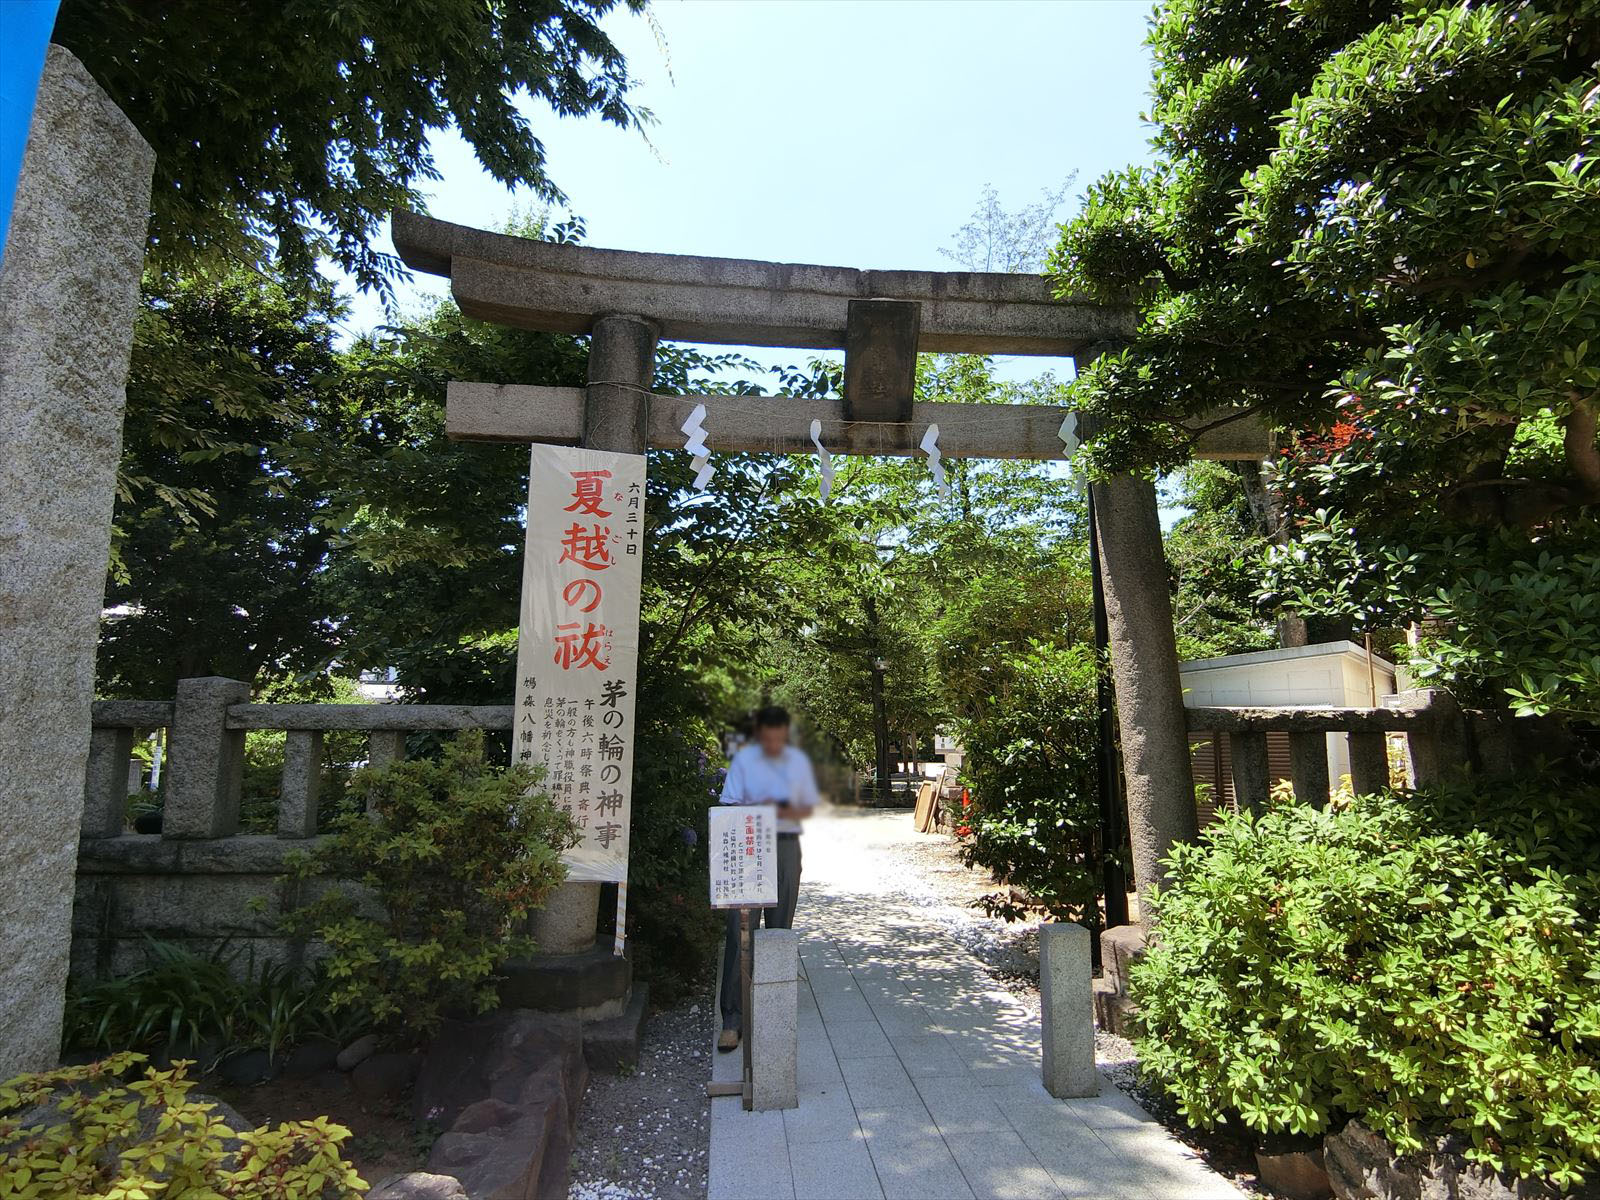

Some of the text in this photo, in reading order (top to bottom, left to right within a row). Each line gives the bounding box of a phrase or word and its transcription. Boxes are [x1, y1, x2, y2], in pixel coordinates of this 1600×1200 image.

[554, 470, 613, 672] 夏越の祓
[626, 482, 641, 556] 六月三十日
[594, 679, 628, 850] 茅の輪の神事
[745, 814, 755, 856] 全面禁煙
